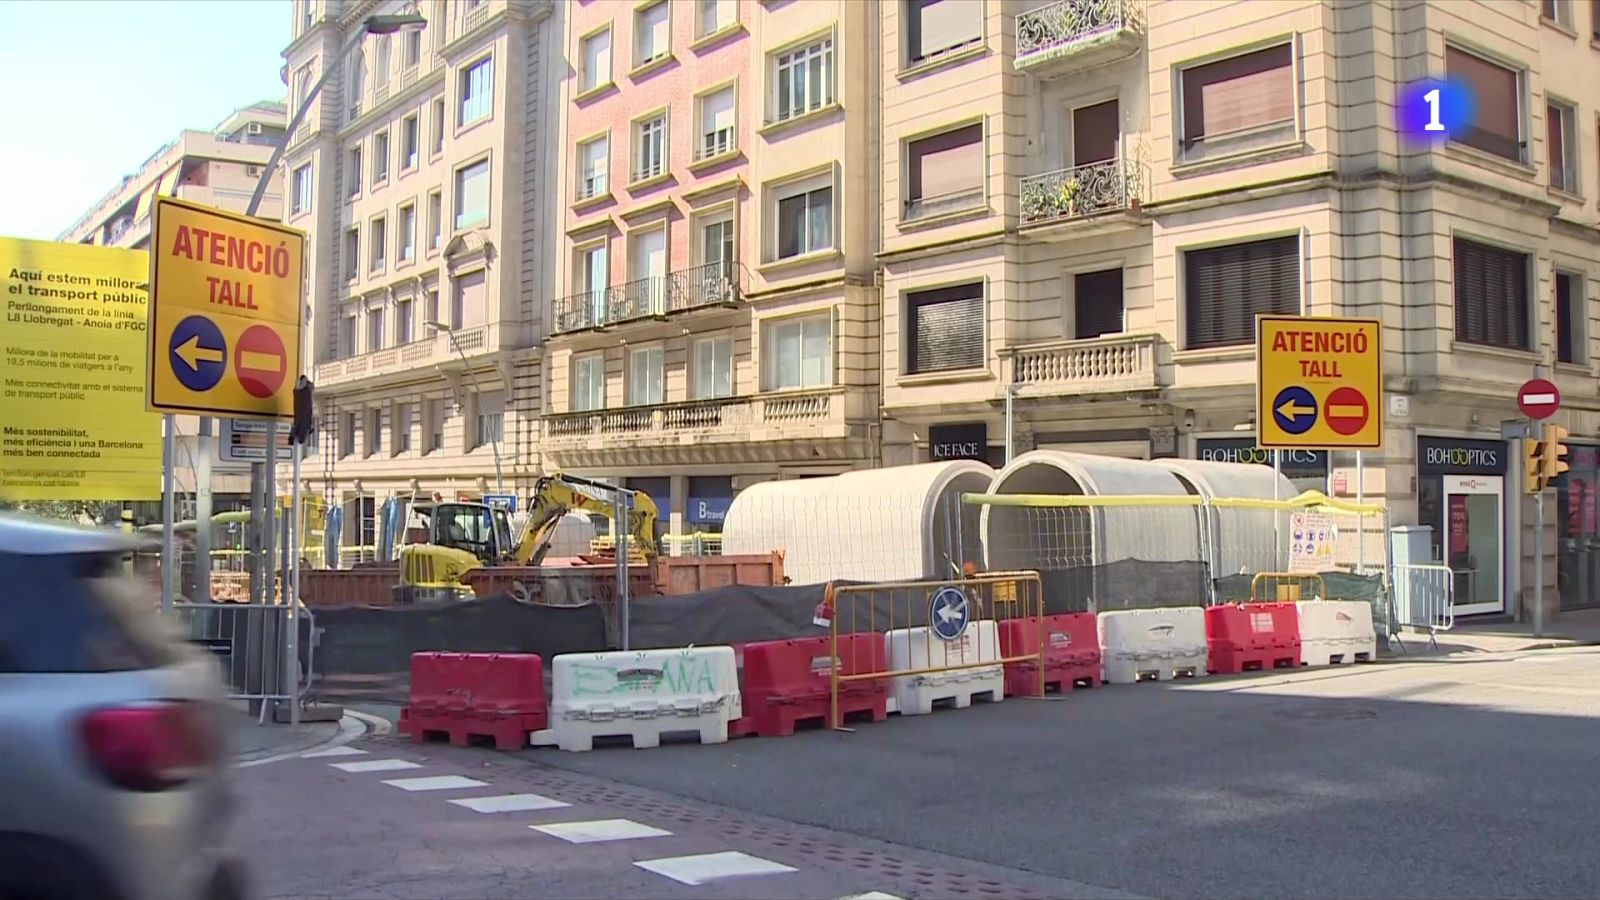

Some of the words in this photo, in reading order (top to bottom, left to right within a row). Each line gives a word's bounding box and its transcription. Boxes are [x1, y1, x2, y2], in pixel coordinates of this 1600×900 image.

[171, 224, 290, 279] ATENCIÓ
[9, 268, 42, 282] Aquí
[47, 273, 91, 285] estem
[96, 276, 146, 289] millor
[8, 284, 22, 294] el
[28, 285, 98, 301] transport
[103, 291, 147, 305] públic
[206, 276, 258, 310] TALL
[8, 301, 84, 316] Perllongament
[87, 306, 100, 316] de
[103, 307, 111, 317] la
[7, 313, 20, 322] L8
[23, 314, 73, 327] Llobregat
[83, 318, 112, 329] Anoia
[115, 320, 146, 331] d'FGC
[1272, 328, 1368, 353] ATENCIÓ
[6, 347, 35, 357] Millora
[37, 349, 48, 357] de
[1299, 360, 1343, 377] TALL
[98, 440, 143, 449] Barcelona
[934, 443, 951, 457] ICE
[952, 442, 978, 456] FACE
[26, 449, 44, 457] ben
[46, 450, 100, 458] connectada
